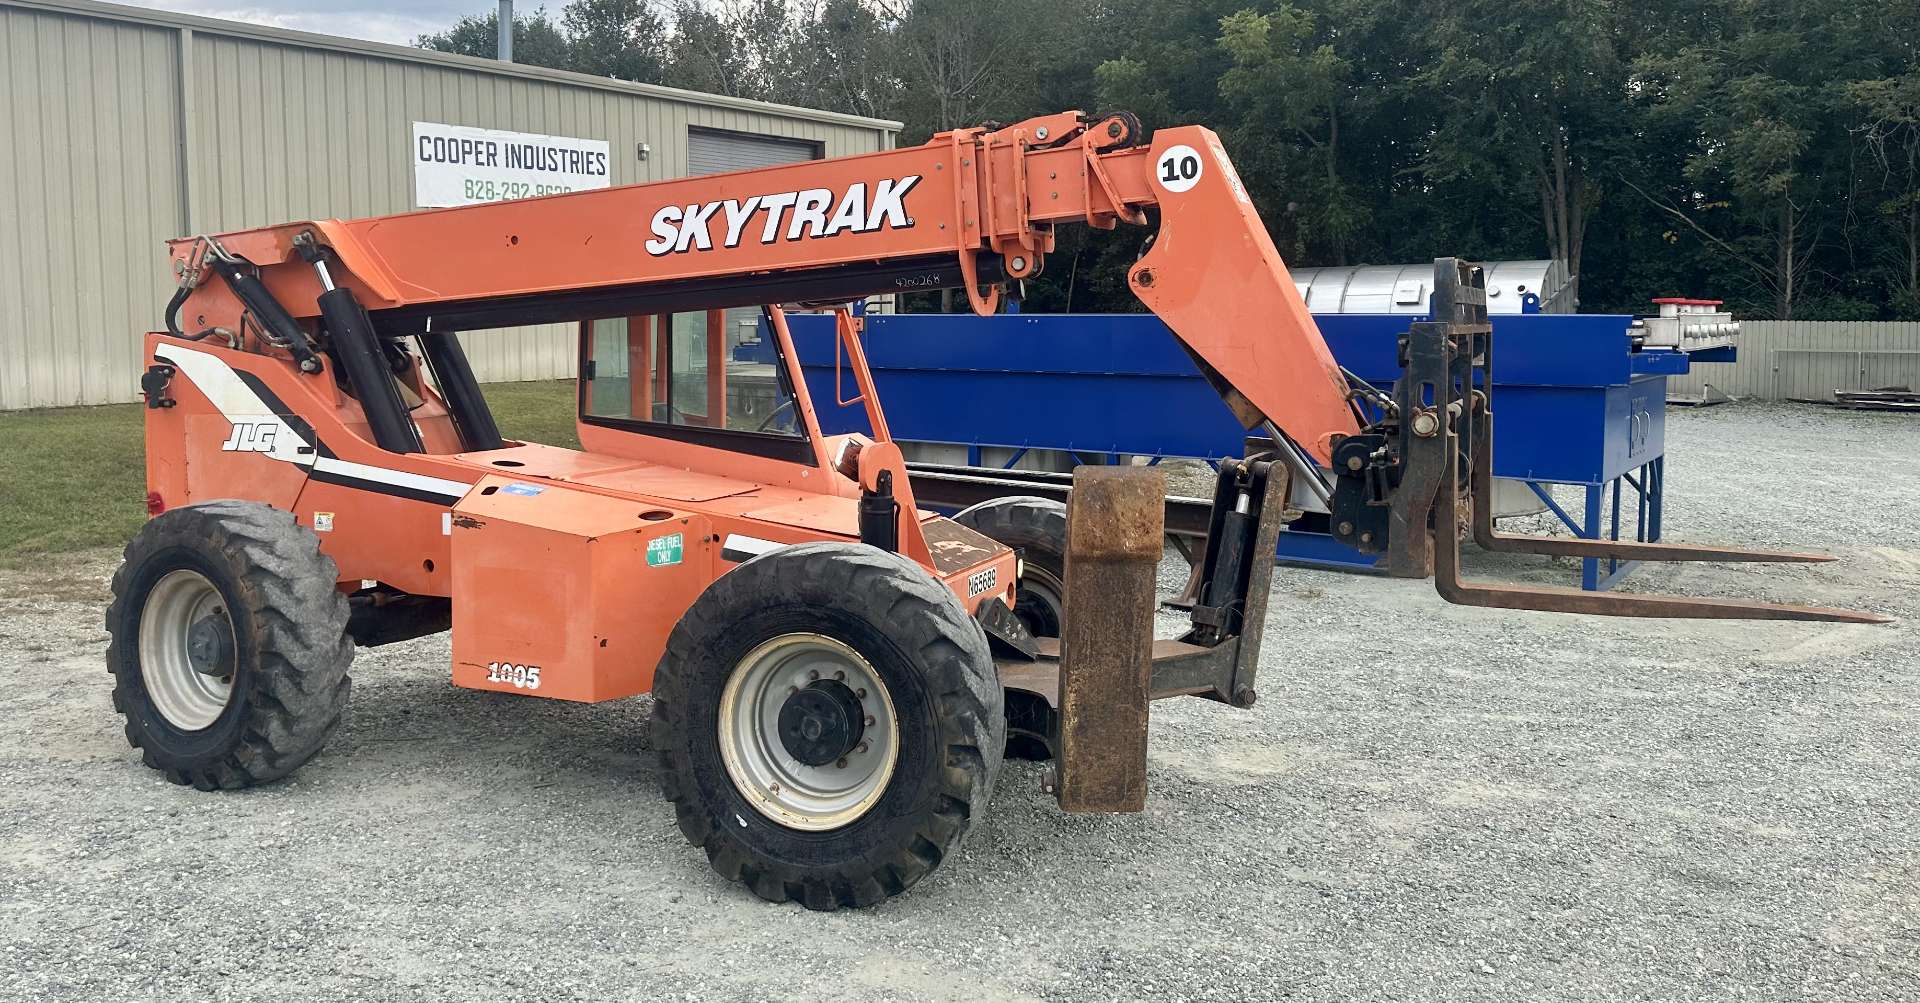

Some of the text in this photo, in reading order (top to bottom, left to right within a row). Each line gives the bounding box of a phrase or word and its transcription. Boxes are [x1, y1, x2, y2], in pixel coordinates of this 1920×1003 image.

[419, 135, 606, 176] COOPER INDUSTRIES
[1162, 156, 1198, 182] 10
[645, 175, 923, 258] SKYTRAK
[222, 423, 278, 452] JLG
[646, 535, 681, 551] DIESEL FUEL
[657, 550, 671, 564] ONLY
[968, 569, 996, 596] N65689
[486, 661, 541, 690] 1005
